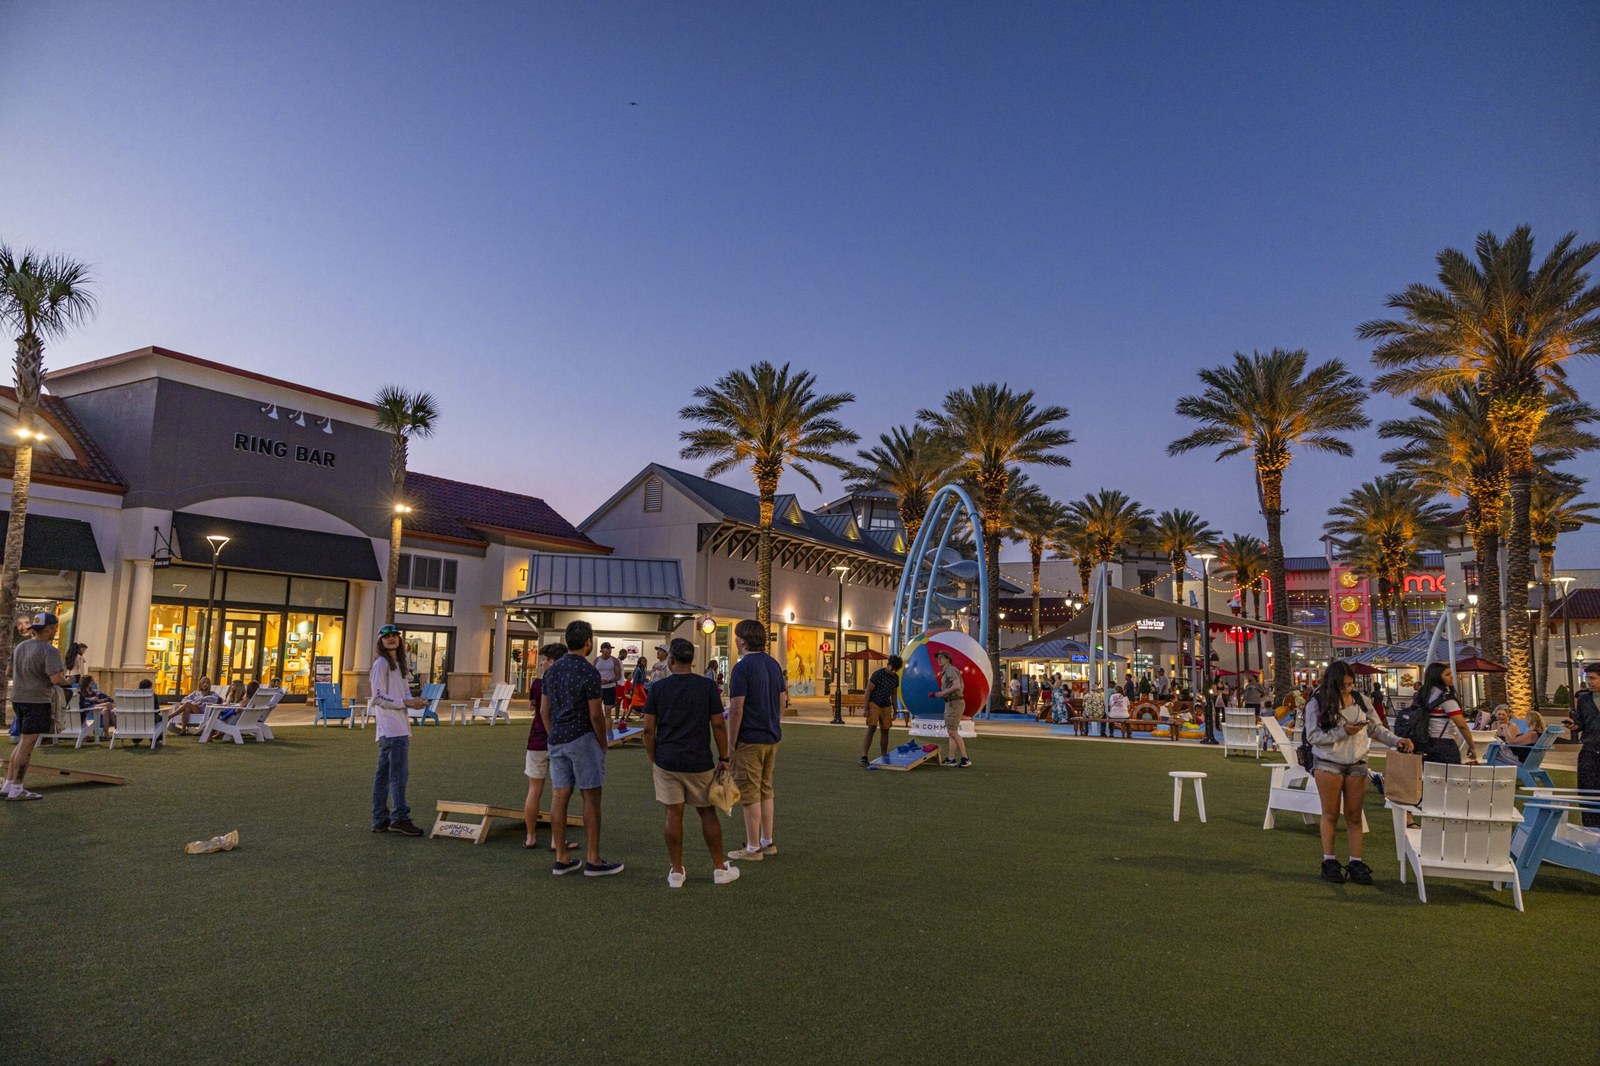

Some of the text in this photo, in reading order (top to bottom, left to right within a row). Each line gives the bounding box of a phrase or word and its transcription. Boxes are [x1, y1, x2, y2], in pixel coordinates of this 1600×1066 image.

[234, 432, 335, 468] RING BAR
[922, 723, 963, 731] COMMS
